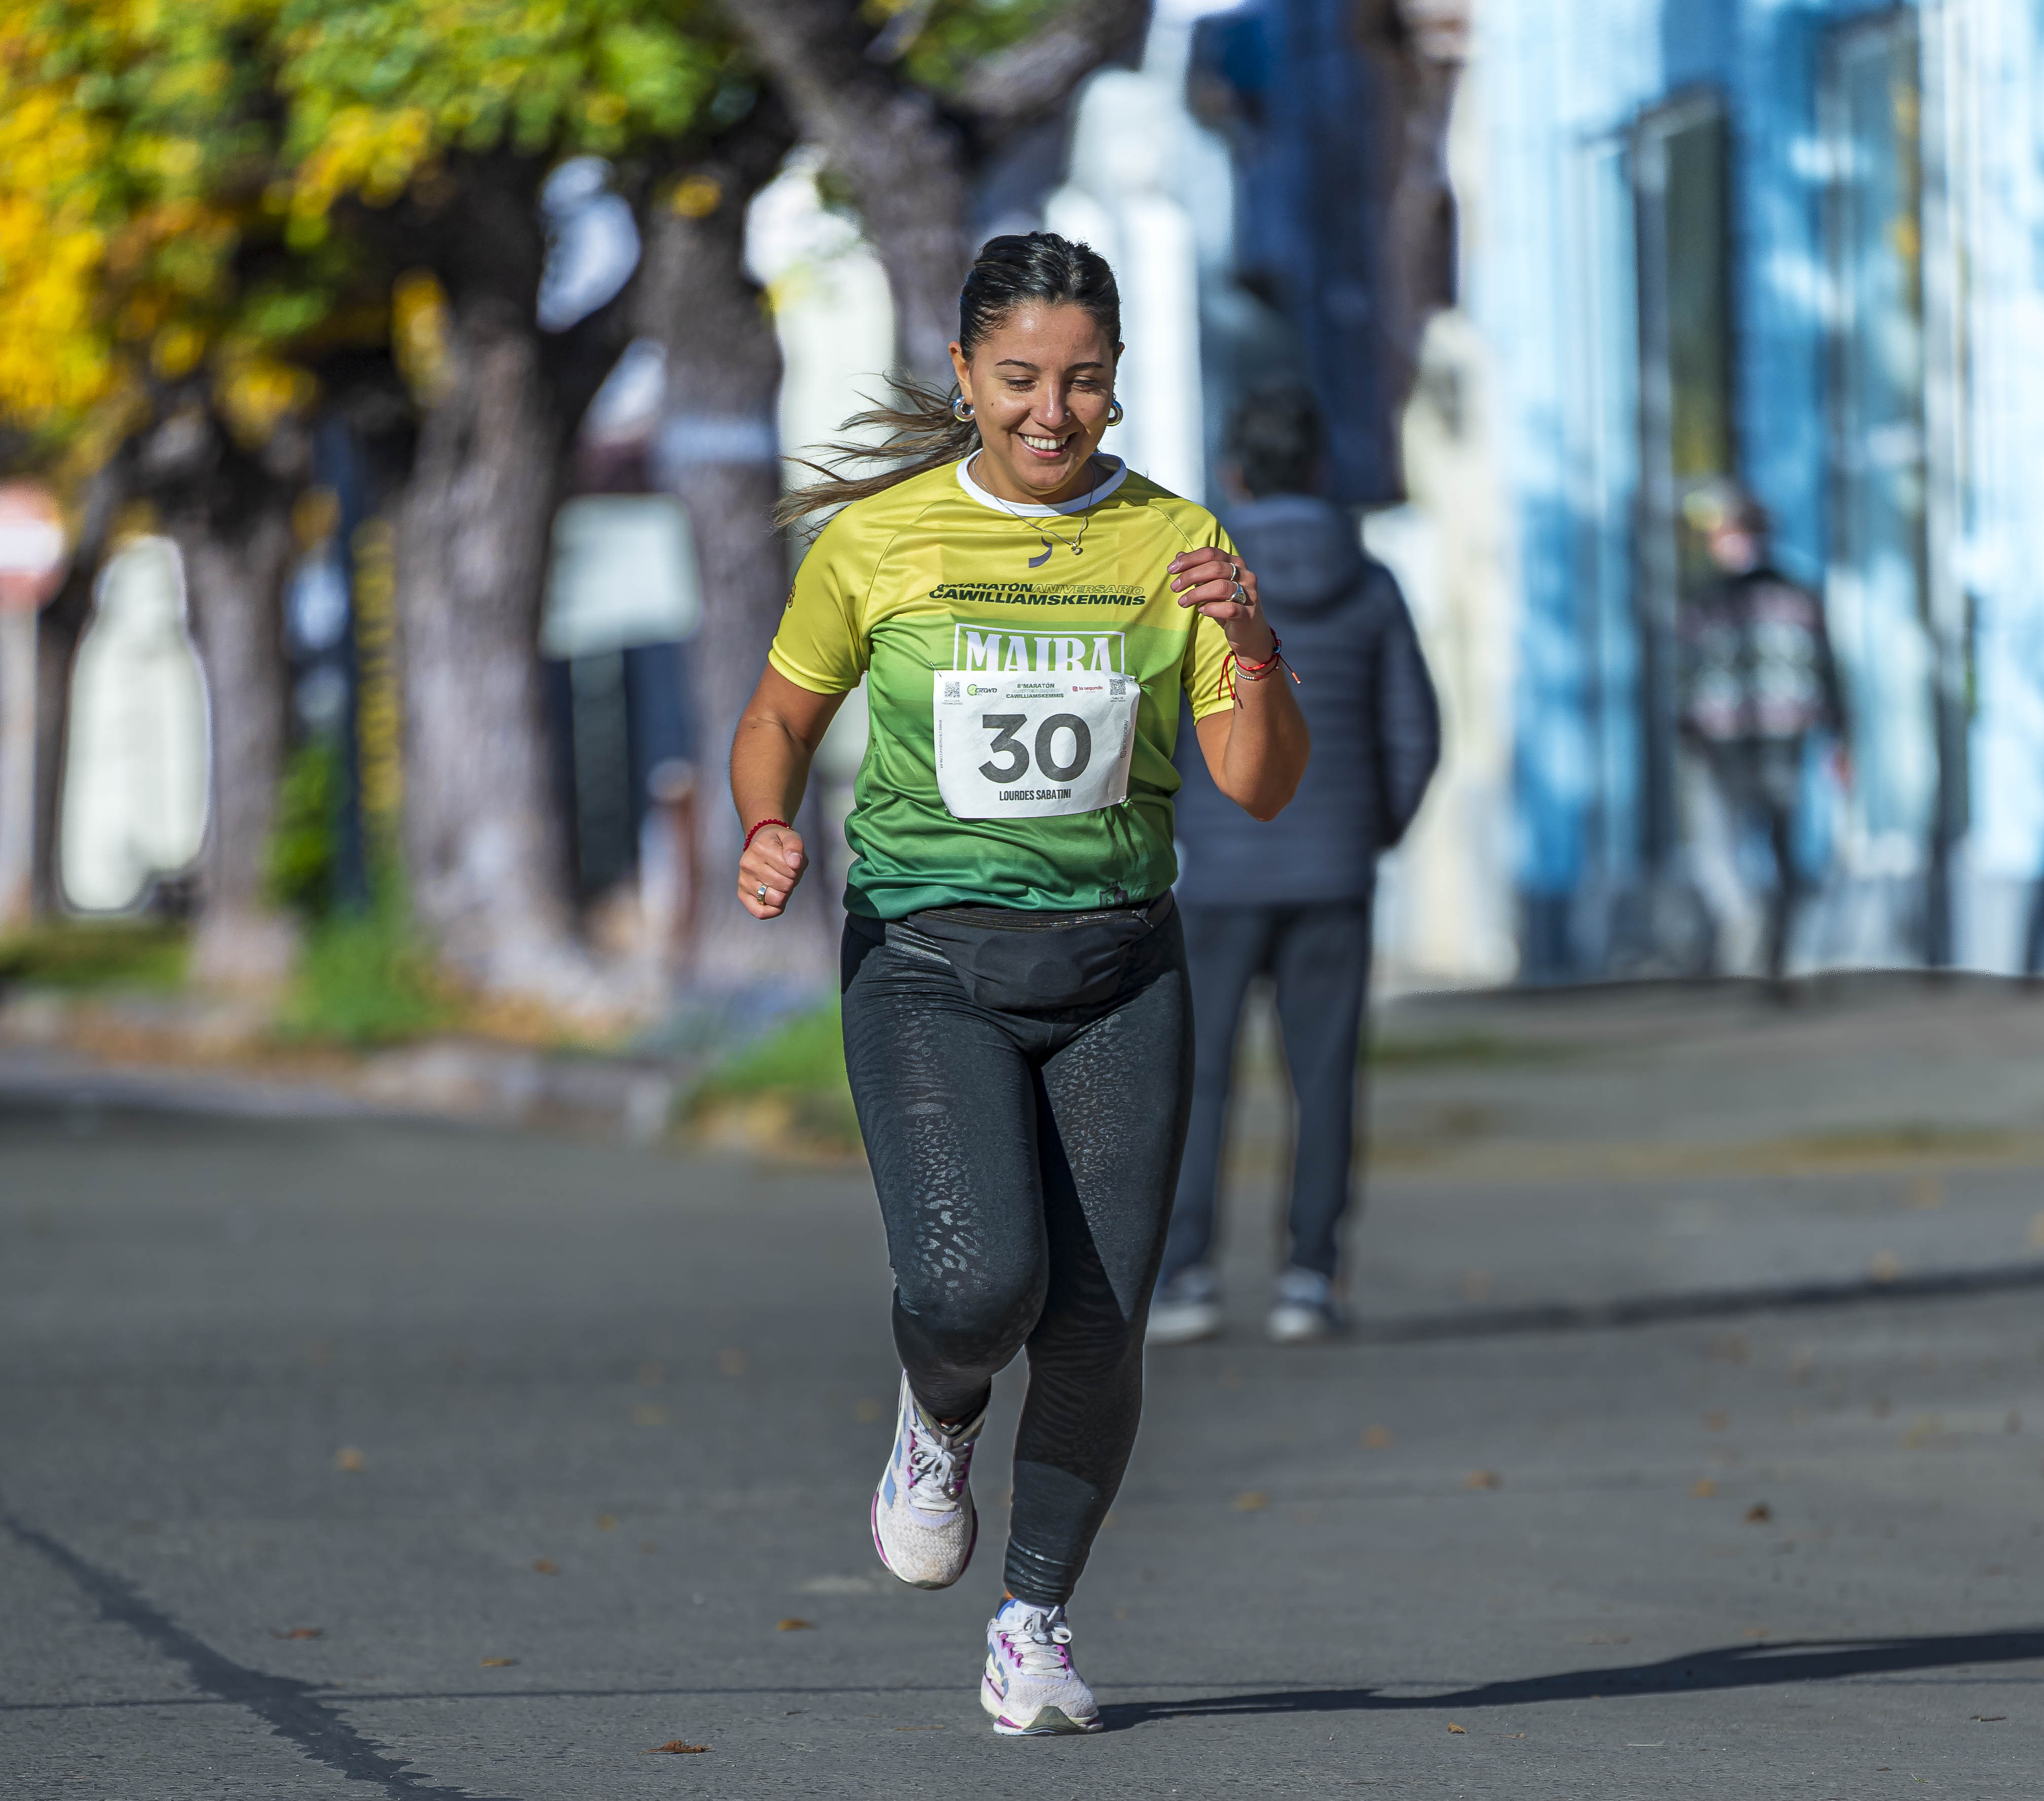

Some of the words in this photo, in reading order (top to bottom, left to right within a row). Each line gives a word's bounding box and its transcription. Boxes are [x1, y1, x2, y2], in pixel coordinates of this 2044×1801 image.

[929, 588, 1146, 606] CAWILLIAMSKEMMIS
[1031, 584, 1144, 596] ANIVERSARIO
[965, 631, 1112, 672] MAIRA
[978, 713, 1091, 783] 30
[999, 790, 1034, 801] LOURDES
[1036, 789, 1071, 800] SABATINI
